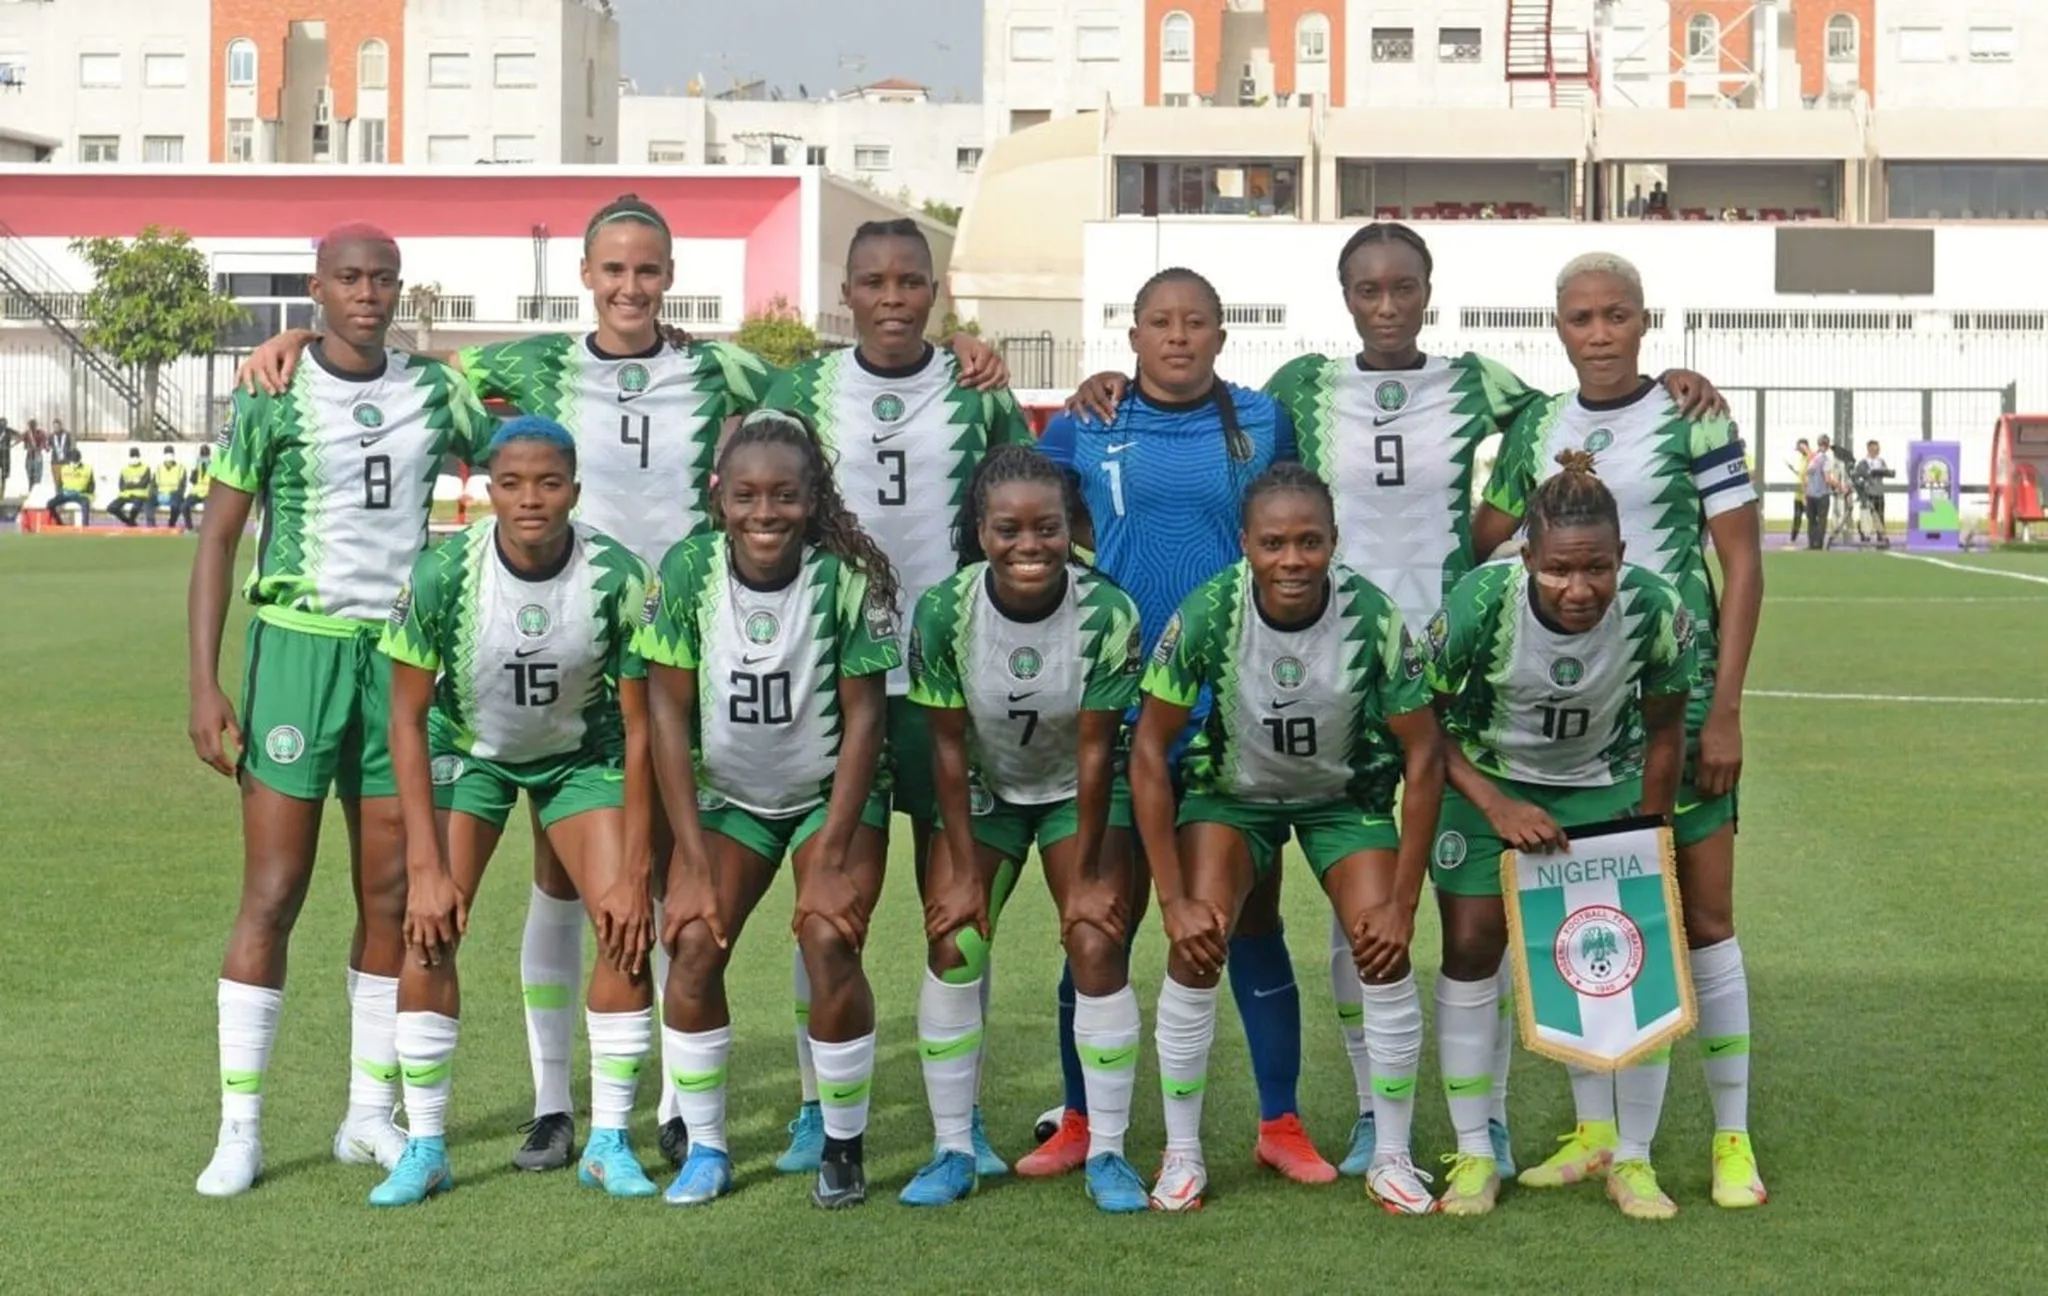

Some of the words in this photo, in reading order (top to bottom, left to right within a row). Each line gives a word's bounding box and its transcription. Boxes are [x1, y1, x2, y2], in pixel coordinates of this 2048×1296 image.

[621, 416, 649, 469] 4
[1375, 435, 1405, 487] 9
[365, 456, 391, 510] 8
[877, 450, 906, 506] 3
[1102, 460, 1124, 516] 1
[503, 663, 561, 707] 15
[729, 671, 793, 725] 20
[1008, 709, 1038, 746] 7
[1263, 716, 1317, 758] 18
[1534, 706, 1589, 741] 10
[1537, 853, 1643, 886] NIGERIA
[1563, 910, 1607, 934] FOOTBALL
[1613, 914, 1641, 968] FEDERATION
